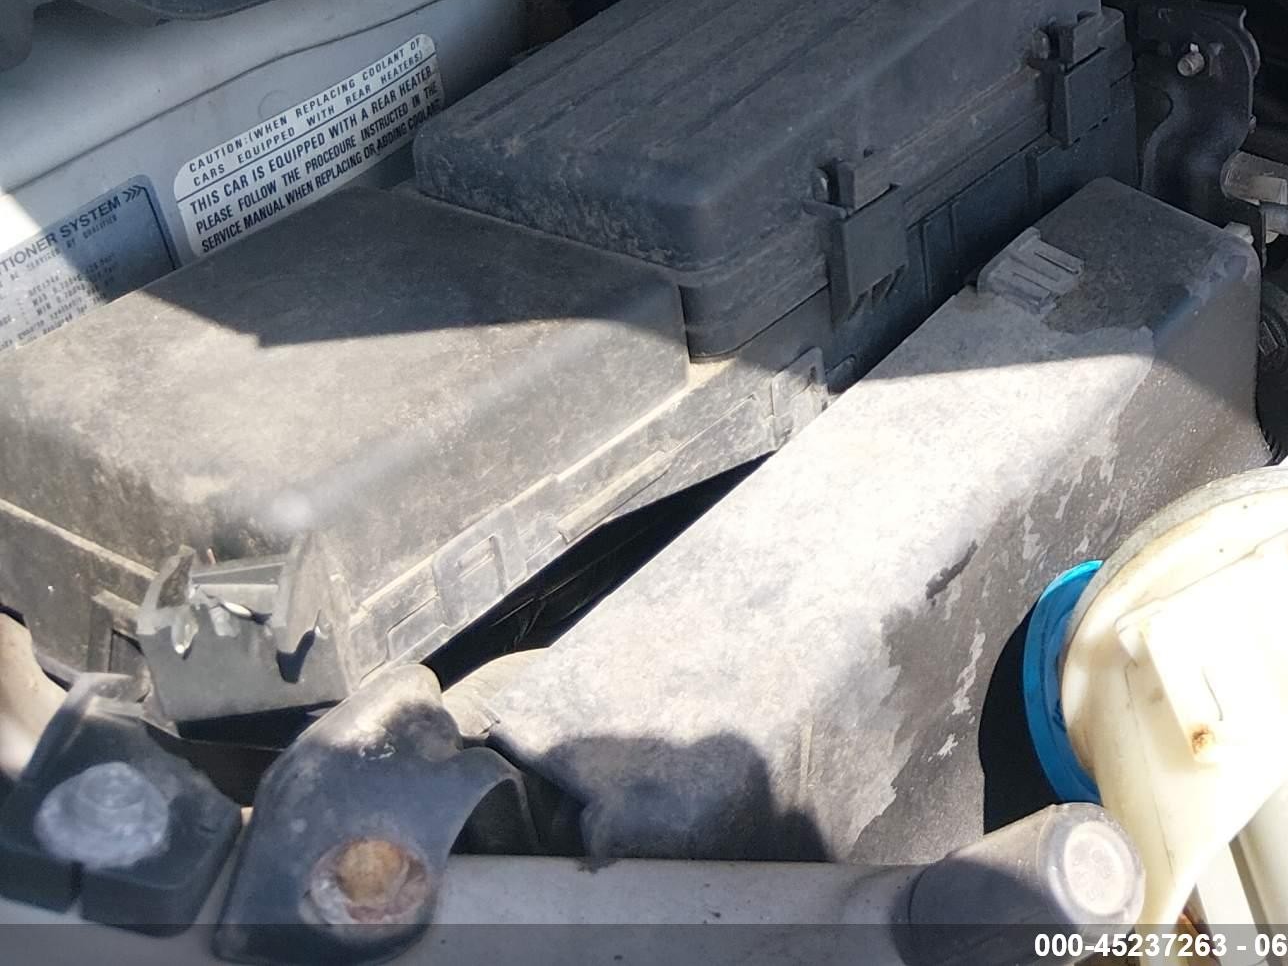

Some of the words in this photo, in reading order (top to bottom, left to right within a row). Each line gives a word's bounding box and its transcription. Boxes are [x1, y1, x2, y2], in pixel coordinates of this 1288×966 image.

[193, 163, 225, 187] CARS
[237, 126, 295, 164] EQUIPPED
[306, 105, 335, 127] WITH
[345, 84, 371, 106] REAR
[380, 50, 423, 84] HEATERS)
[295, 78, 356, 118] REPLACING
[362, 49, 404, 81] COOLANT
[410, 37, 421, 51] OF
[190, 189, 220, 215] THIS
[223, 174, 249, 197] CAR
[252, 165, 265, 182] IS
[268, 132, 325, 173] EQUIPPED
[328, 113, 358, 139] WITH
[361, 107, 369, 122] A
[371, 89, 397, 115] REAR
[196, 204, 234, 235] PLEASE
[238, 179, 277, 212] FOLLOW
[281, 166, 302, 187] THE
[304, 135, 356, 174] PROCEDURE
[360, 102, 409, 142] INSTRUCTED
[411, 94, 421, 109] IN
[424, 80, 438, 100] THE
[201, 220, 243, 253] SERVICE
[243, 197, 287, 230] MANUAL
[285, 180, 315, 206] WHEN
[315, 151, 363, 189] REPLACING
[363, 142, 377, 160] OR
[376, 122, 408, 151] ADDING
[59, 195, 121, 239] SYSTEM
